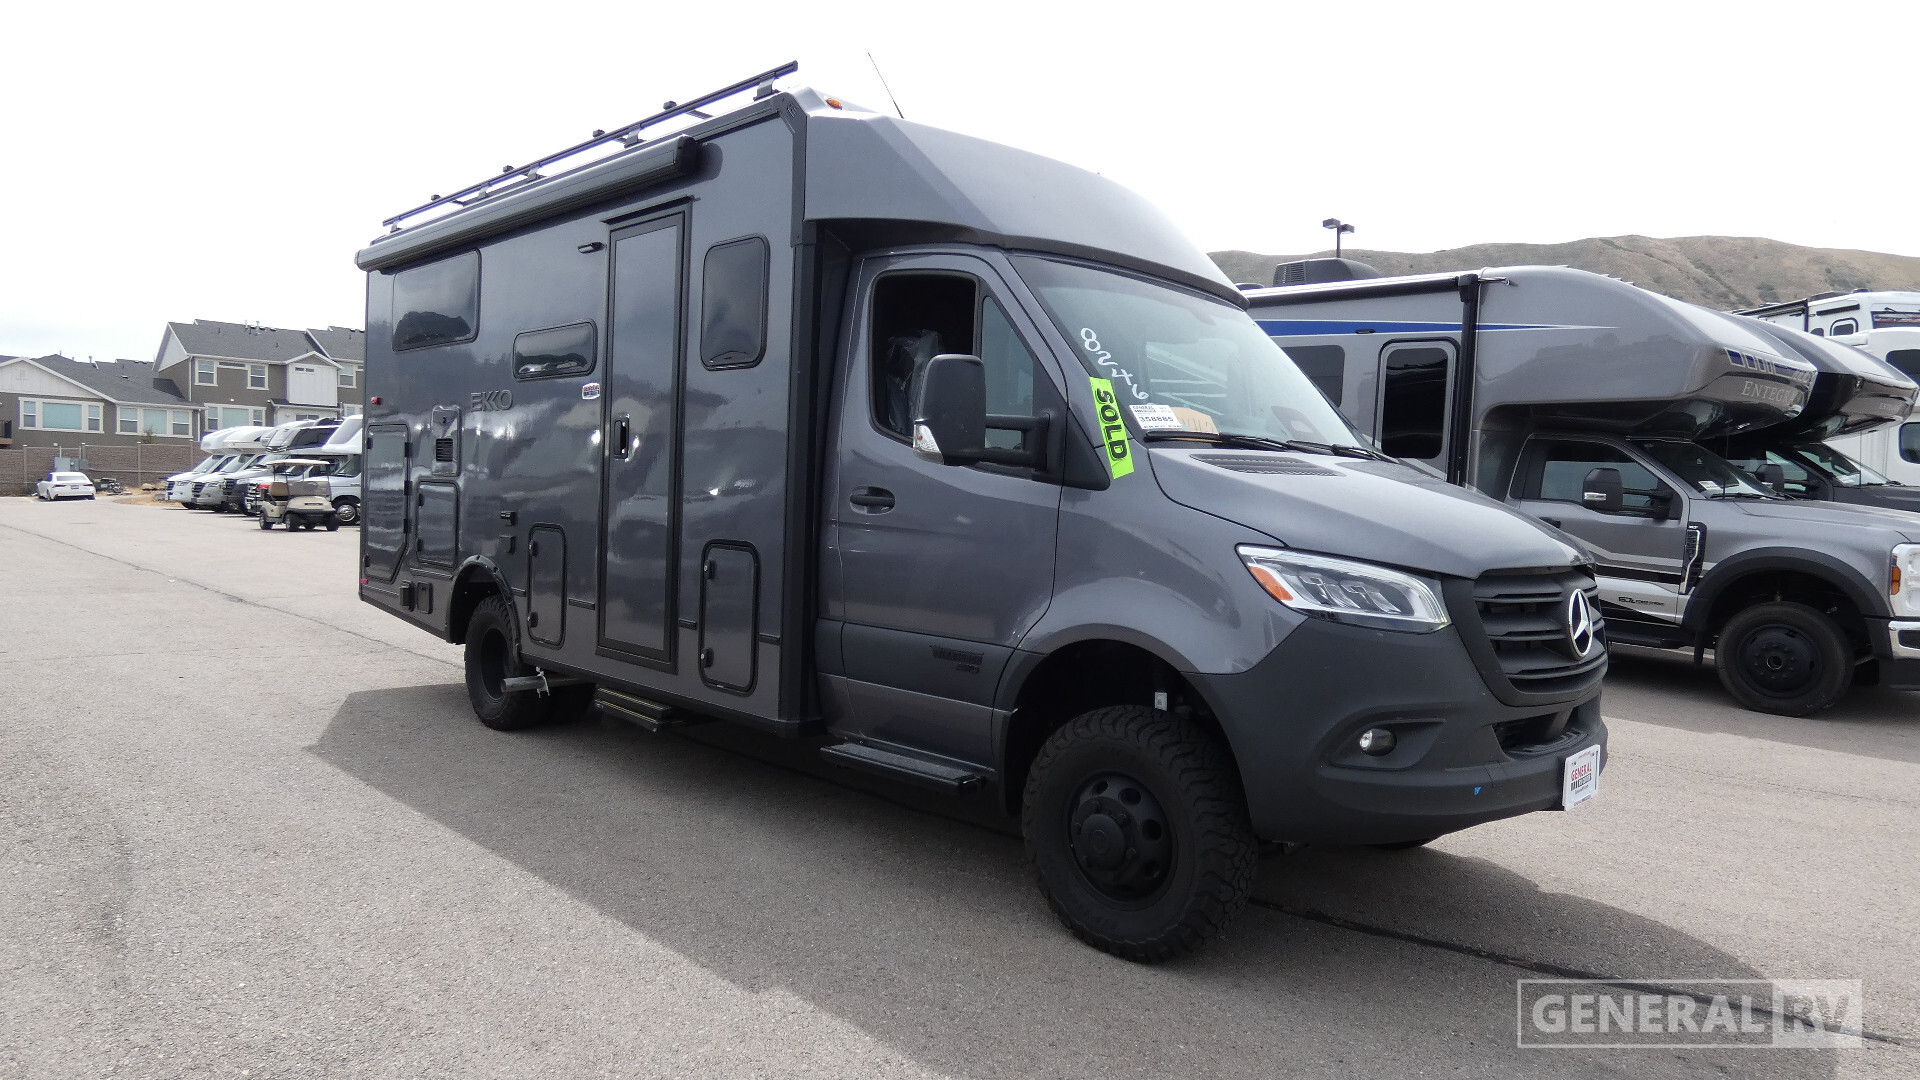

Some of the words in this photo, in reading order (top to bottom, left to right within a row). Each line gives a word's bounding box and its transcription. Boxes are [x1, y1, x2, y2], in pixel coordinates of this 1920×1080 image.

[1080, 327, 1149, 400] 8246
[470, 389, 513, 412] EKKO
[1095, 388, 1128, 461] SOLD
[1570, 761, 1592, 782] GENERAL
